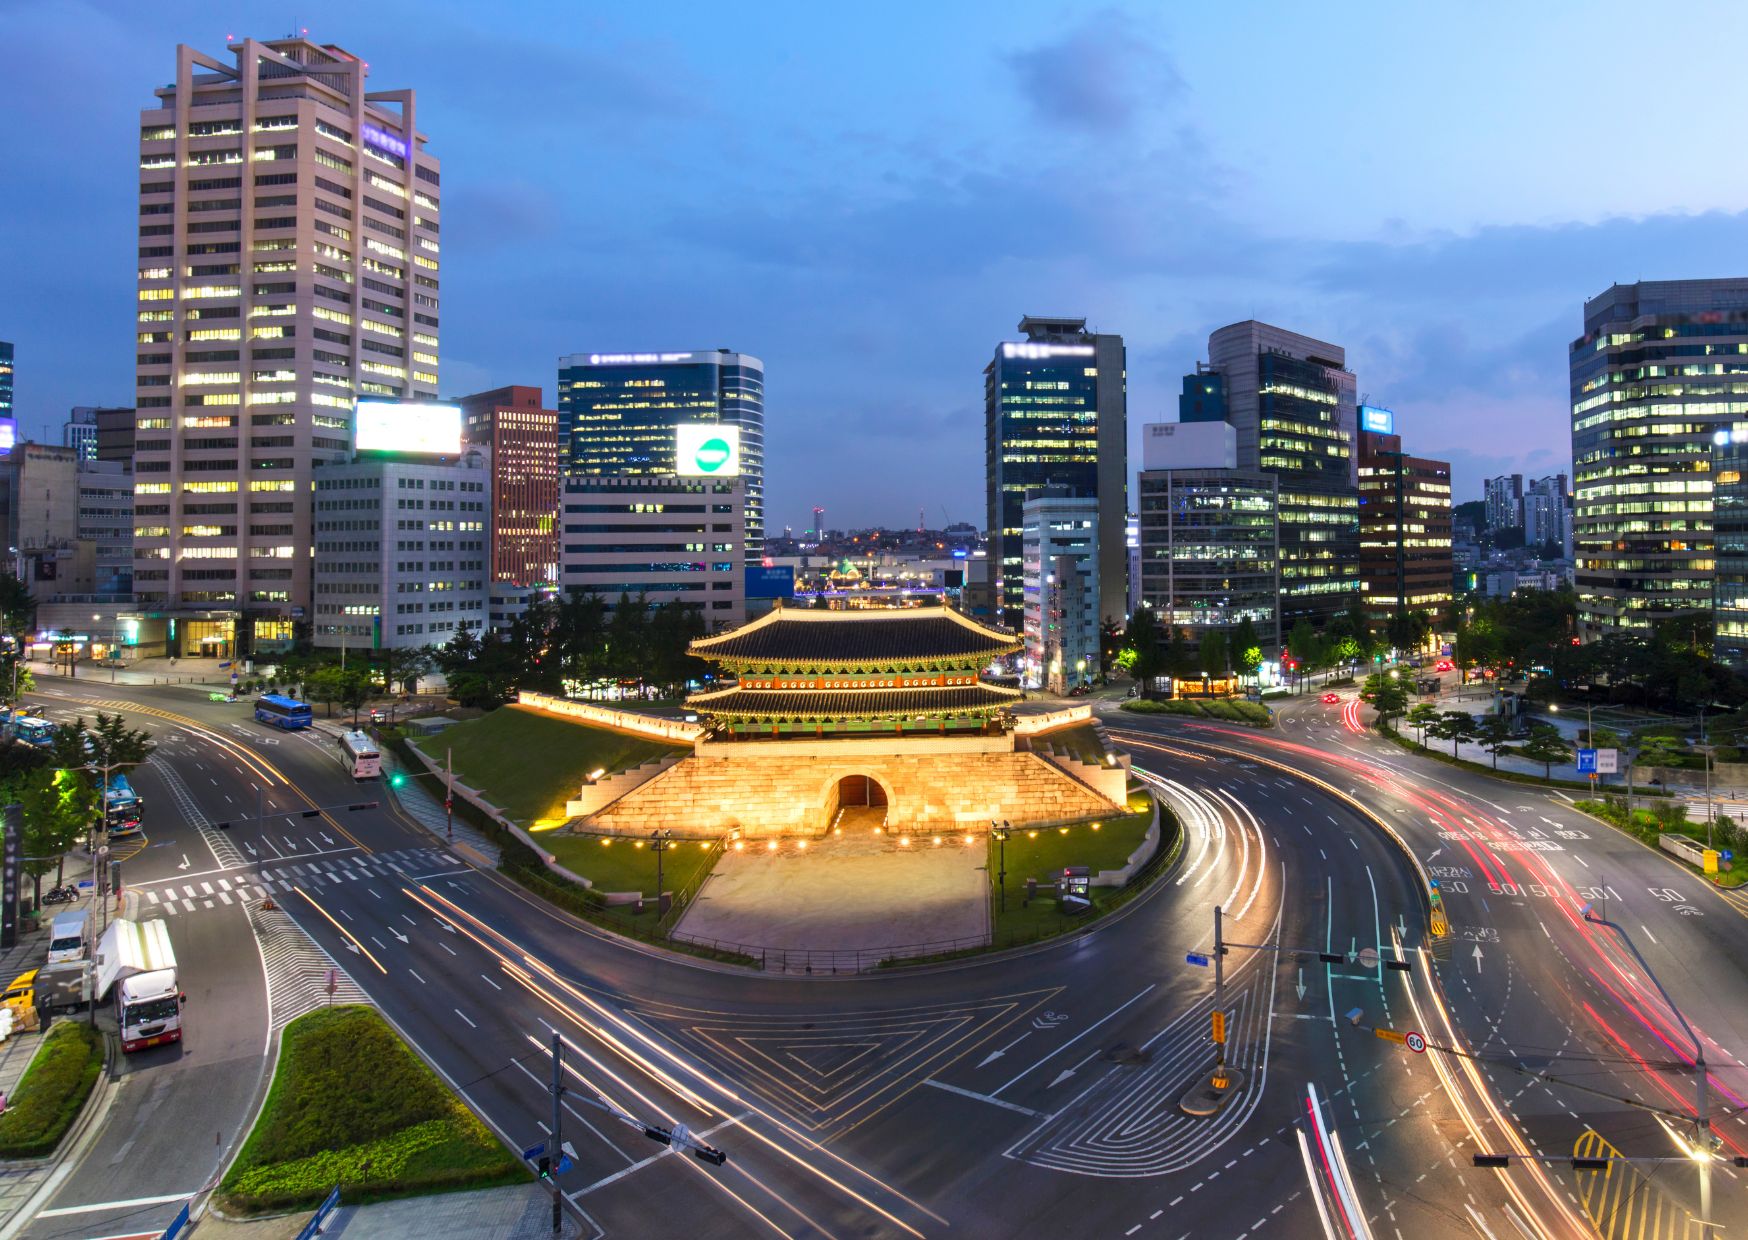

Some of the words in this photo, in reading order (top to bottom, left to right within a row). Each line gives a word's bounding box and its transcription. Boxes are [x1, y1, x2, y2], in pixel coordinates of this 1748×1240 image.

[1439, 880, 1469, 894] 50
[1487, 882, 1519, 896] 50
[1528, 884, 1560, 899] 50
[1647, 887, 1687, 902] 50
[1409, 1037, 1423, 1049] 60
